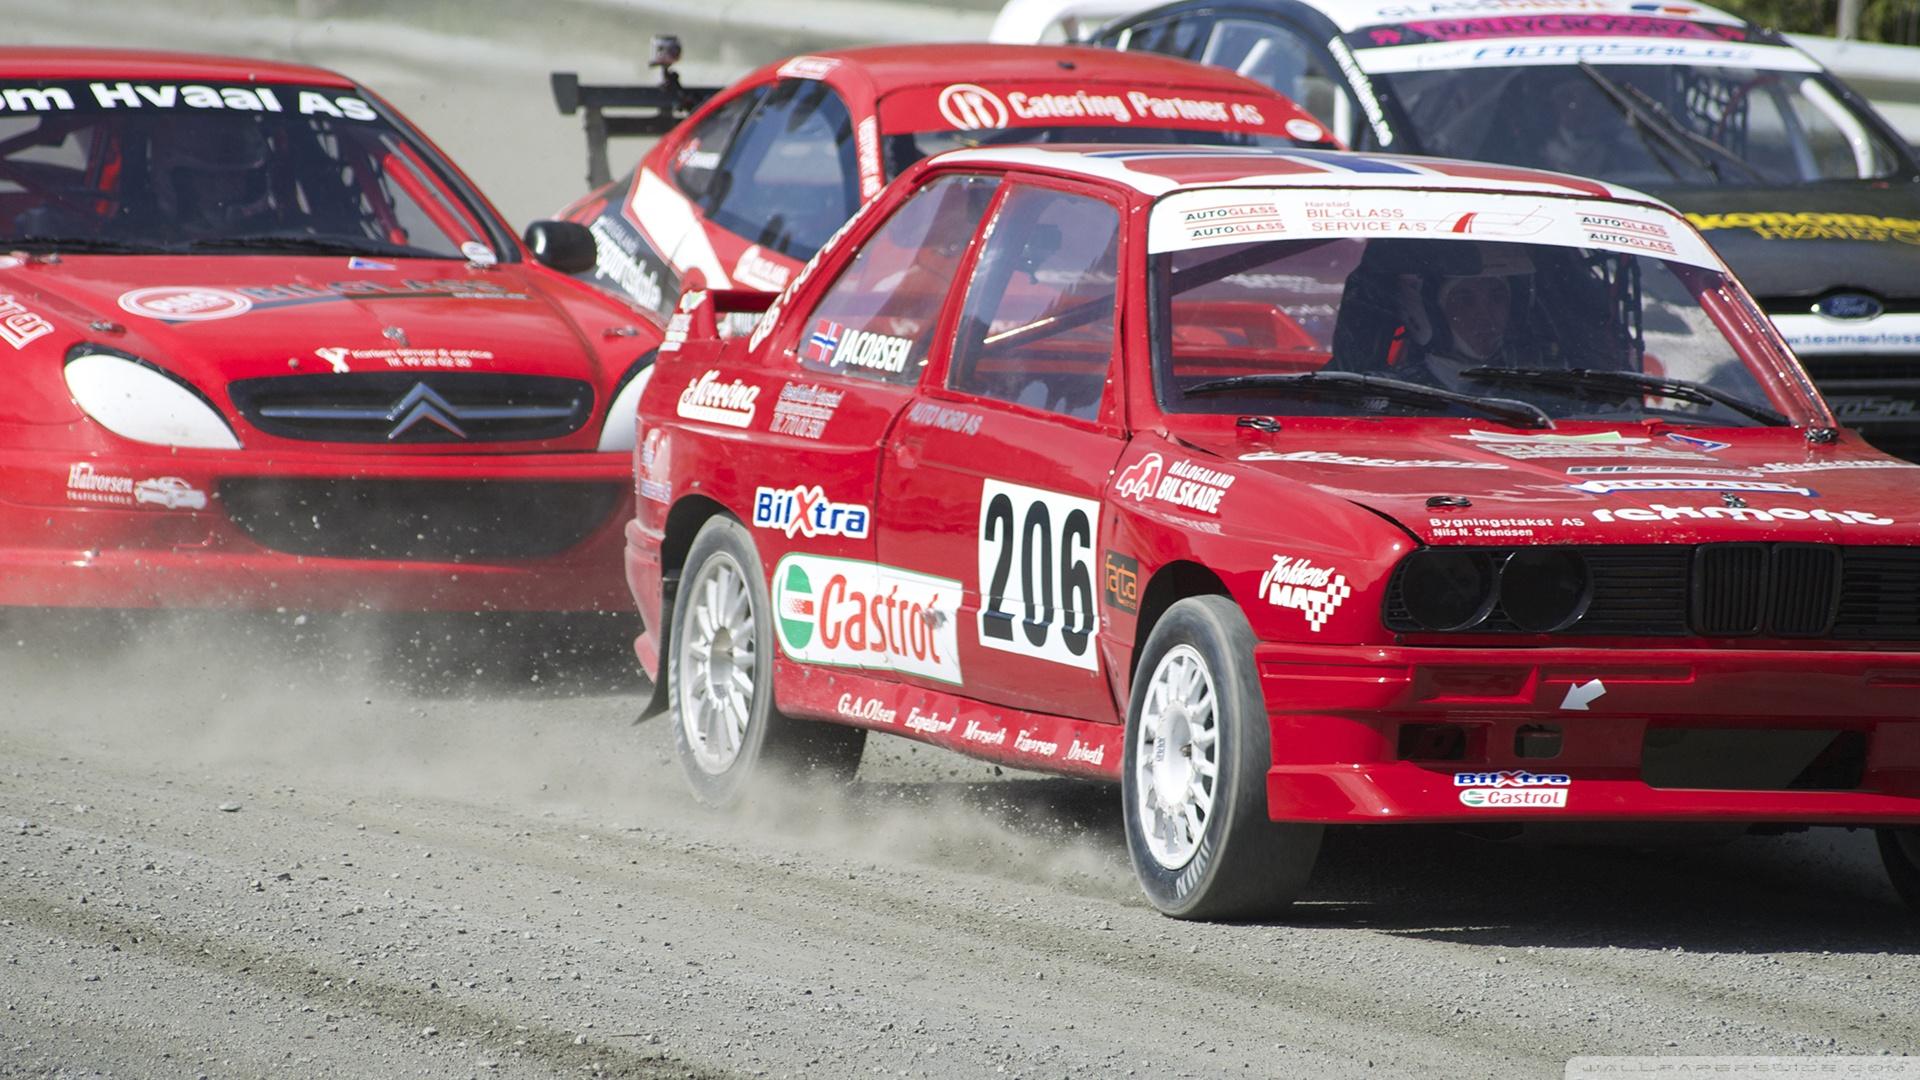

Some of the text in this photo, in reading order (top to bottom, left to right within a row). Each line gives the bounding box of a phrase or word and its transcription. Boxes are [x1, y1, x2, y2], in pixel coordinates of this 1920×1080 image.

[89, 82, 283, 112] Hvaal
[299, 91, 377, 121] As
[1007, 90, 1264, 125] Catering Partner AS
[1186, 206, 1279, 220] AUTOGLASS
[1306, 208, 1404, 219] BIL-GLASS
[1192, 222, 1285, 237] AUTOGLASS
[1312, 221, 1391, 232] SERVICE
[1583, 215, 1668, 236] AUTOGLASS
[1590, 233, 1676, 252] AUTOGLASS
[830, 328, 913, 373] JACOBSEN
[68, 462, 133, 493] Halvorsen
[1156, 476, 1226, 514] BILSKADE
[756, 491, 866, 534] BilXtra
[1429, 518, 1585, 527] Bygningstakst AS
[1433, 528, 1534, 536] Nils N. Svendsen
[984, 493, 1095, 657] 206
[1457, 771, 1569, 786] BilXtra
[1488, 791, 1560, 804] Castrol
